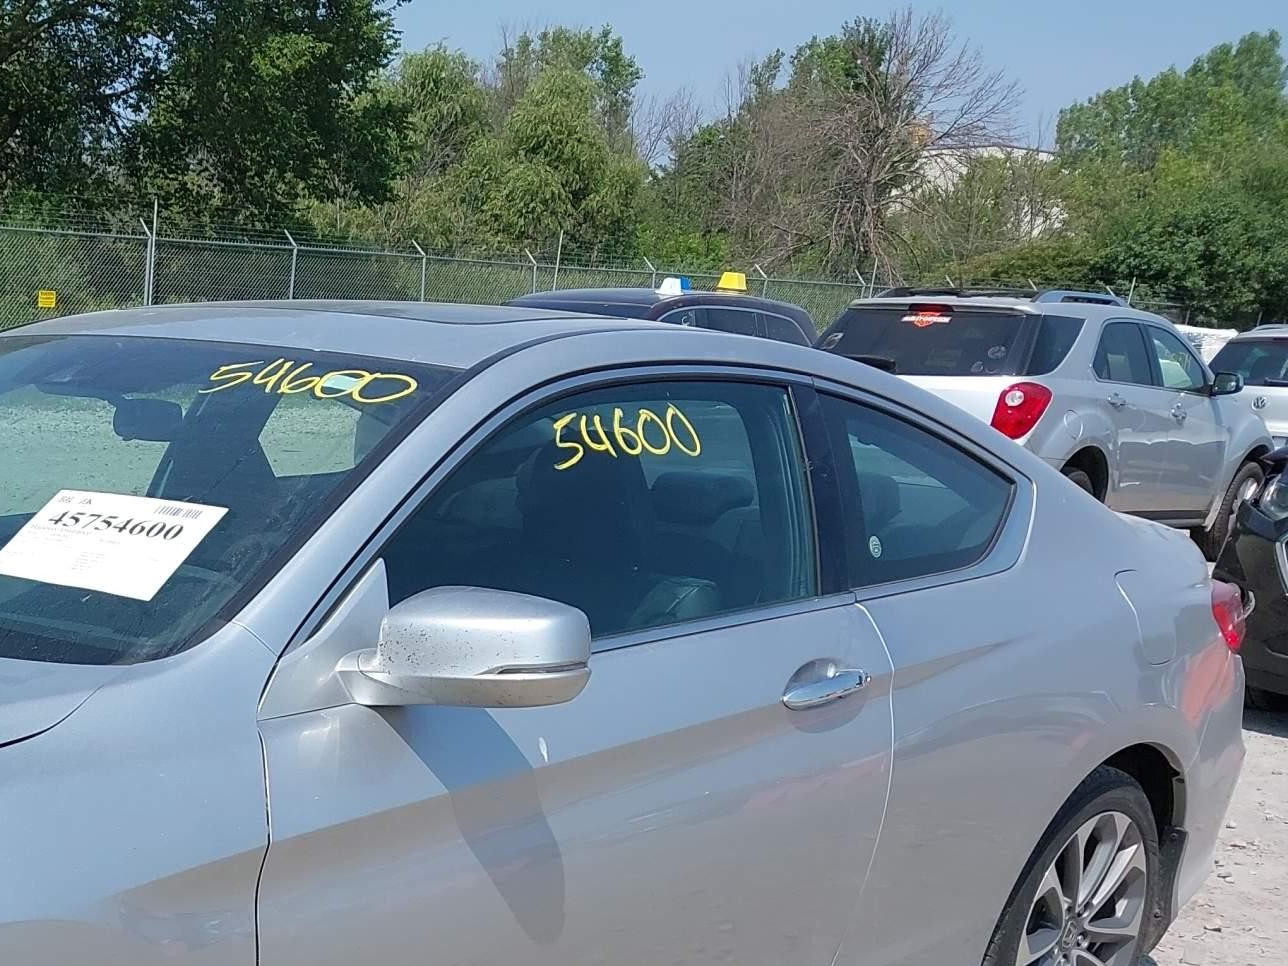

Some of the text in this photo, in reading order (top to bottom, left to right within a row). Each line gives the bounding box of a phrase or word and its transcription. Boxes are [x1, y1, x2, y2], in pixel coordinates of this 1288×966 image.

[198, 358, 418, 403] 54600
[553, 402, 701, 470] 54600
[48, 510, 184, 541] 45754600
